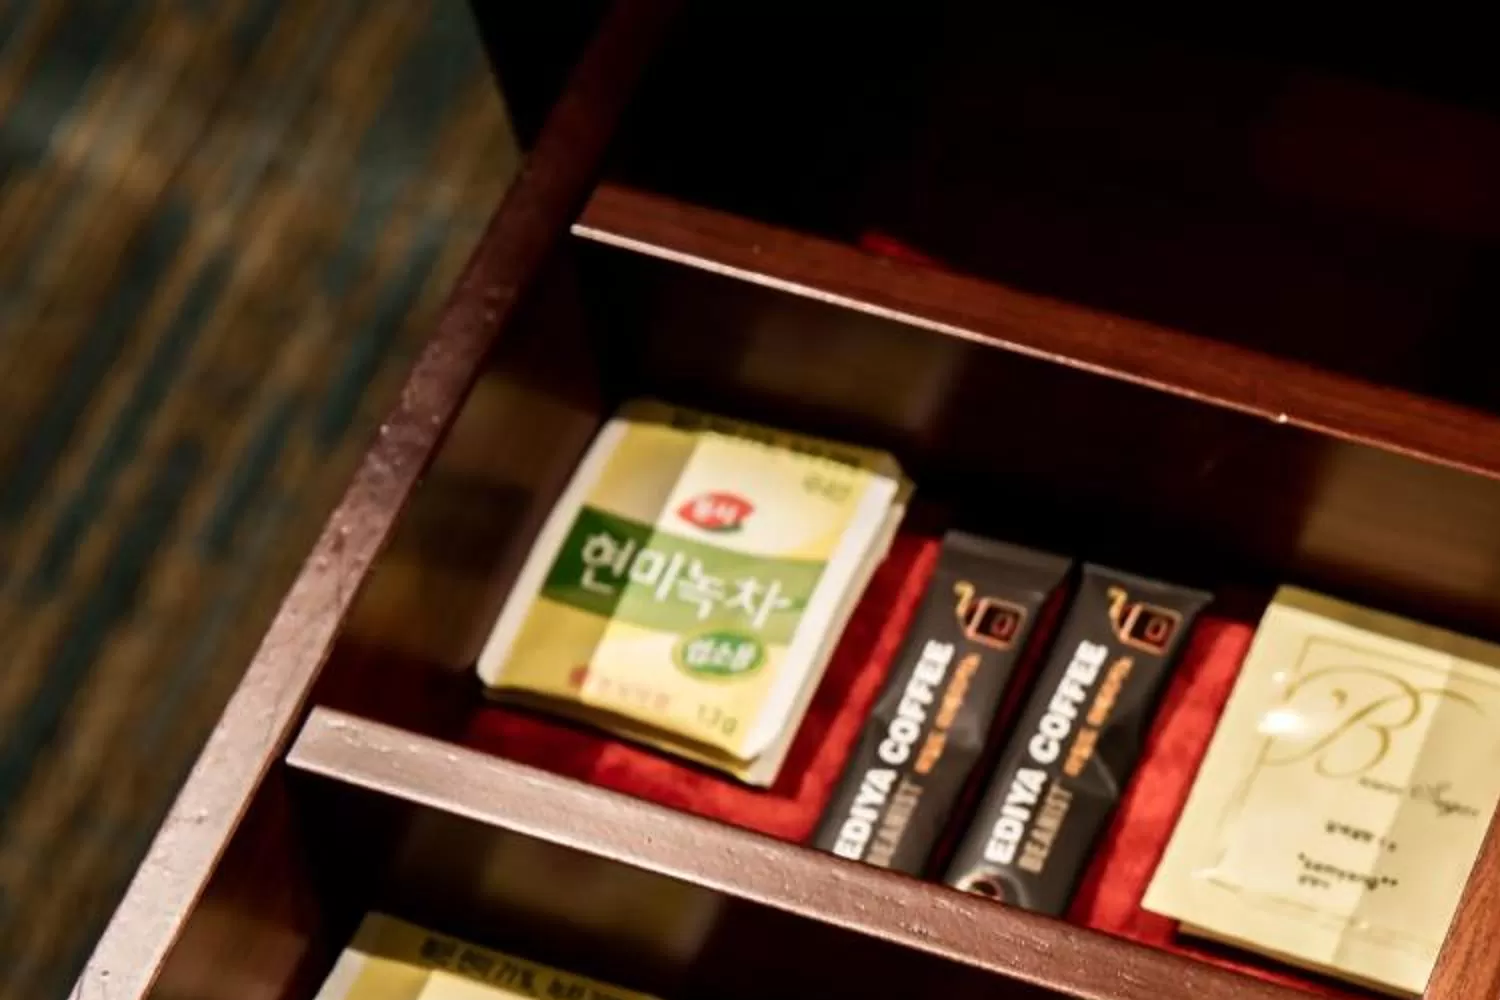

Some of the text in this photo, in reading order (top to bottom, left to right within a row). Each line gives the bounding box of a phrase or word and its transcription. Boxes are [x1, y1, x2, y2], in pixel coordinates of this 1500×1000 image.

[580, 532, 792, 630] 현미녹차
[832, 768, 898, 862] EDIYA
[877, 639, 955, 765] COFFEE
[984, 766, 1048, 865] EDIYA
[1028, 639, 1109, 764] COFFEE
